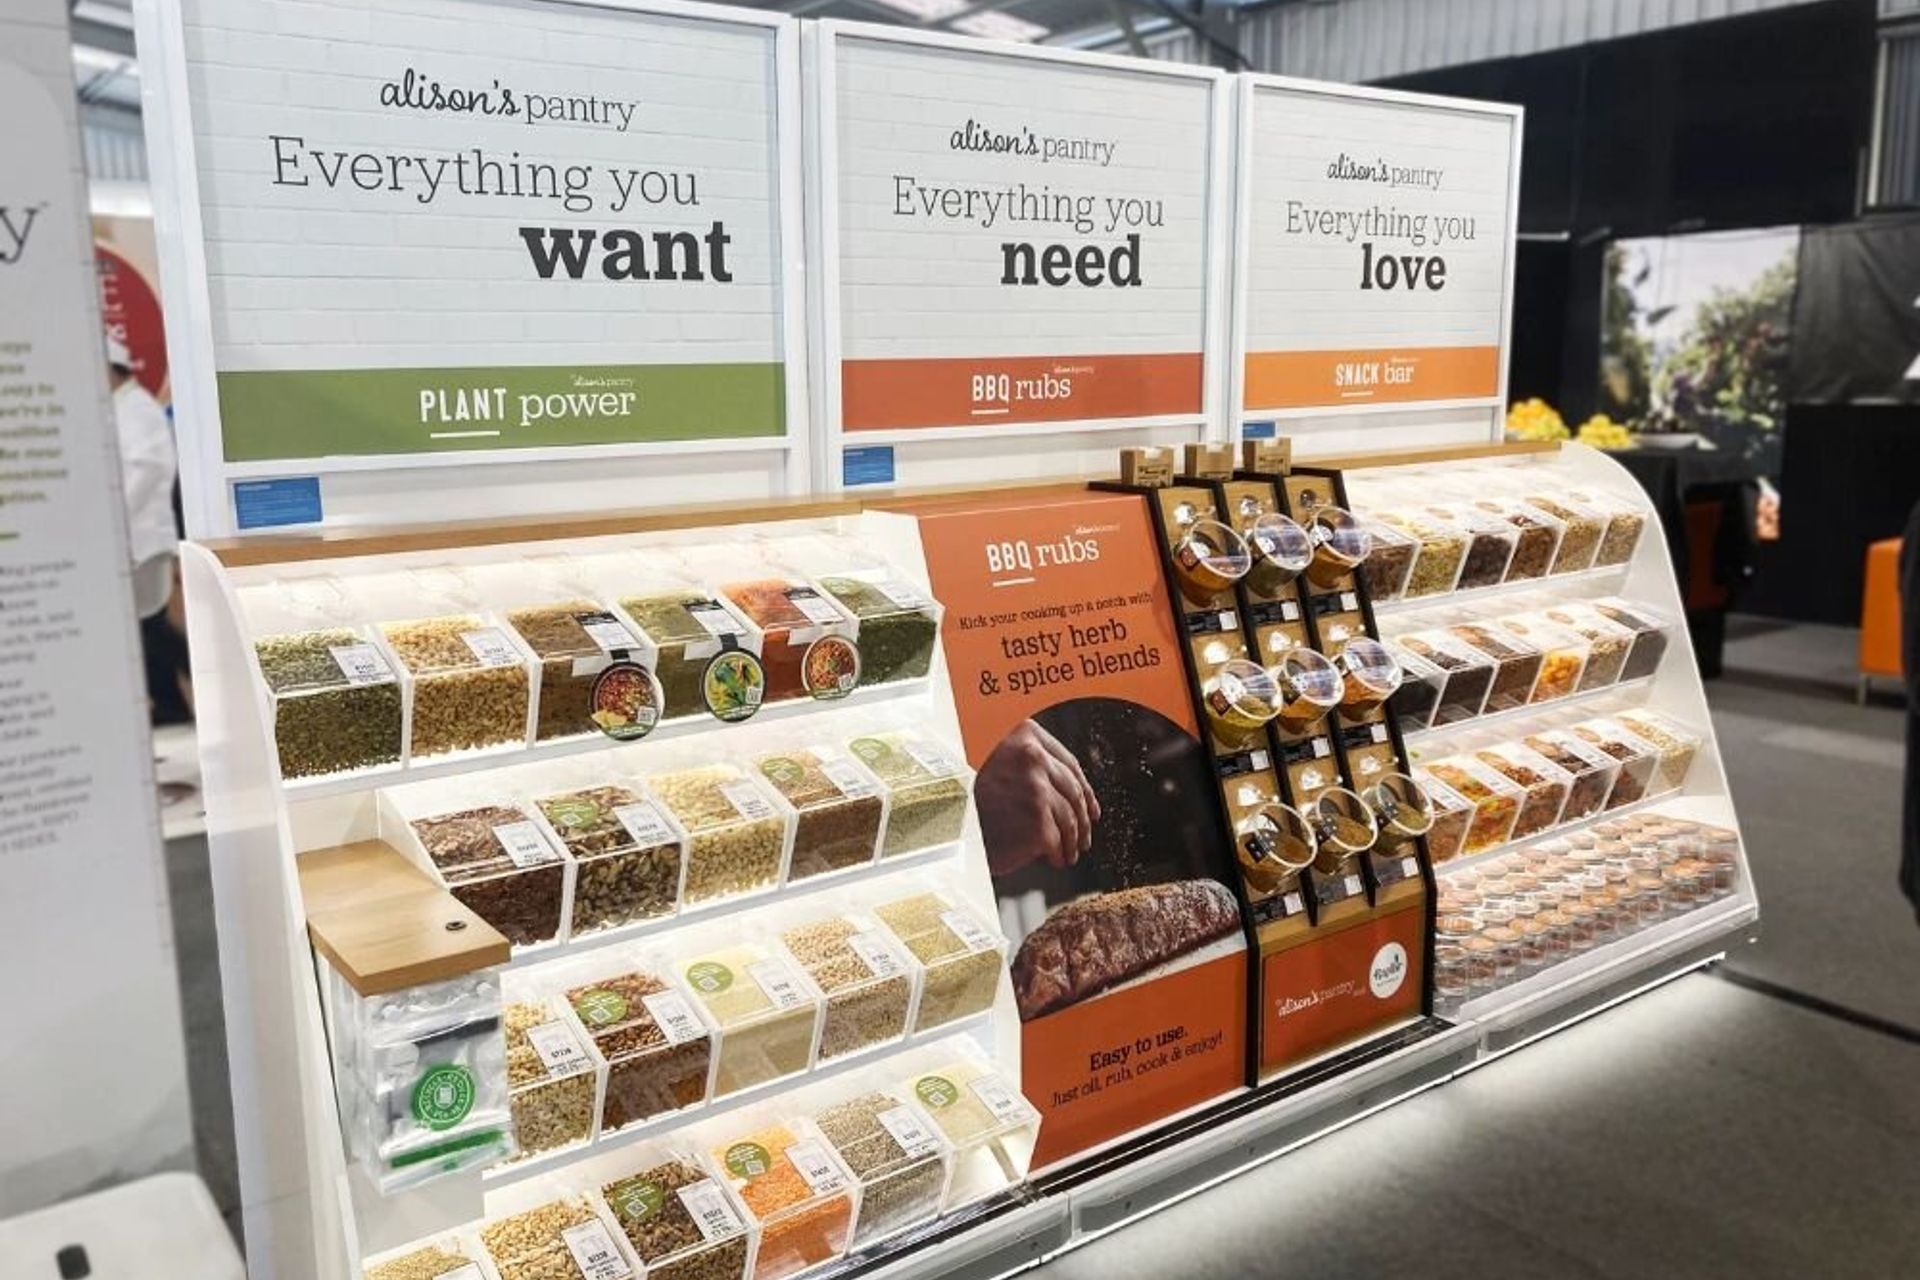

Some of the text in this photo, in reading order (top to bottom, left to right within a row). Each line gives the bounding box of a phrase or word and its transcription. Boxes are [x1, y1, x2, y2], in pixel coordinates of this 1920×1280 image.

[380, 68, 637, 132] alison's pantry
[949, 119, 1116, 167] alison's pantry
[268, 135, 701, 213] Everything you
[1326, 154, 1444, 190] alison's pantry
[892, 175, 1164, 234] Everything you
[1285, 201, 1476, 245] Everything you
[519, 221, 733, 282] want
[999, 234, 1143, 287] need
[1360, 243, 1446, 291] love
[972, 373, 1071, 403] BBQ rubs
[1336, 362, 1414, 386] SNACK bar
[420, 388, 636, 426] PLANT power
[986, 535, 1100, 572] BBQ rubs
[959, 592, 1153, 630] Kick your cooking up a notch with
[1001, 618, 1127, 659] tasty herb
[978, 644, 1161, 696] & spice blends
[1052, 1030, 1223, 1108] Just oil, rub, cook & enjoy!
[1089, 1025, 1188, 1072] Easy to use.
